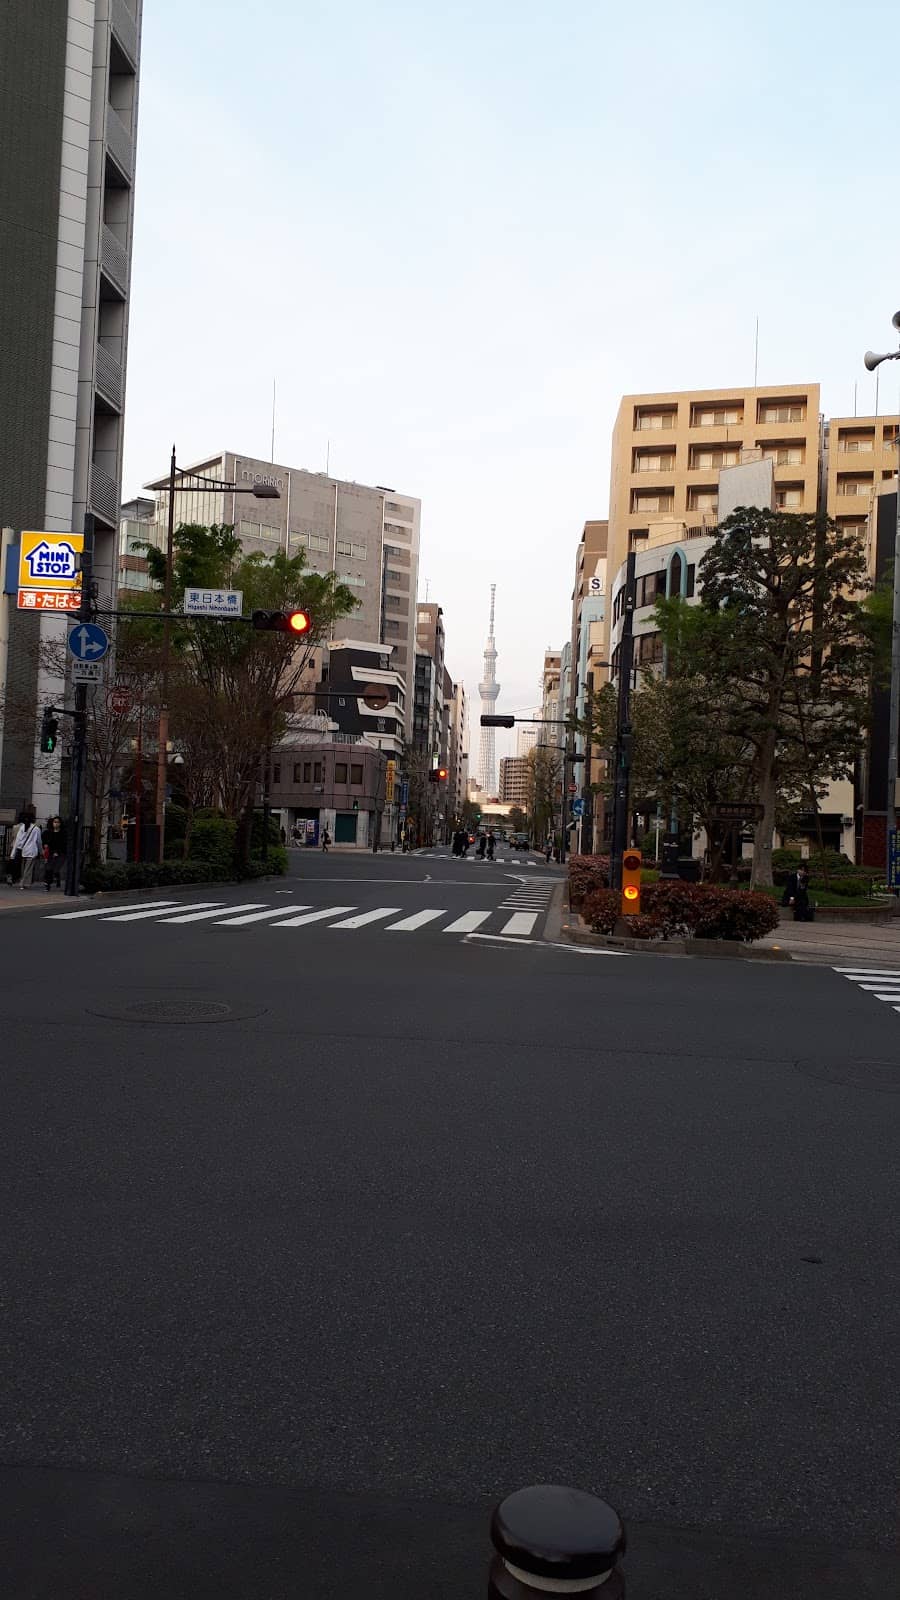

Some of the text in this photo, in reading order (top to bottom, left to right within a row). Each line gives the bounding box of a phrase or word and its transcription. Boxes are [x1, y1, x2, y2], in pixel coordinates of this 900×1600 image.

[39, 551, 69, 562] MINI
[37, 562, 70, 573] STOP
[591, 578, 600, 589] S
[189, 592, 238, 605] 東日本橋
